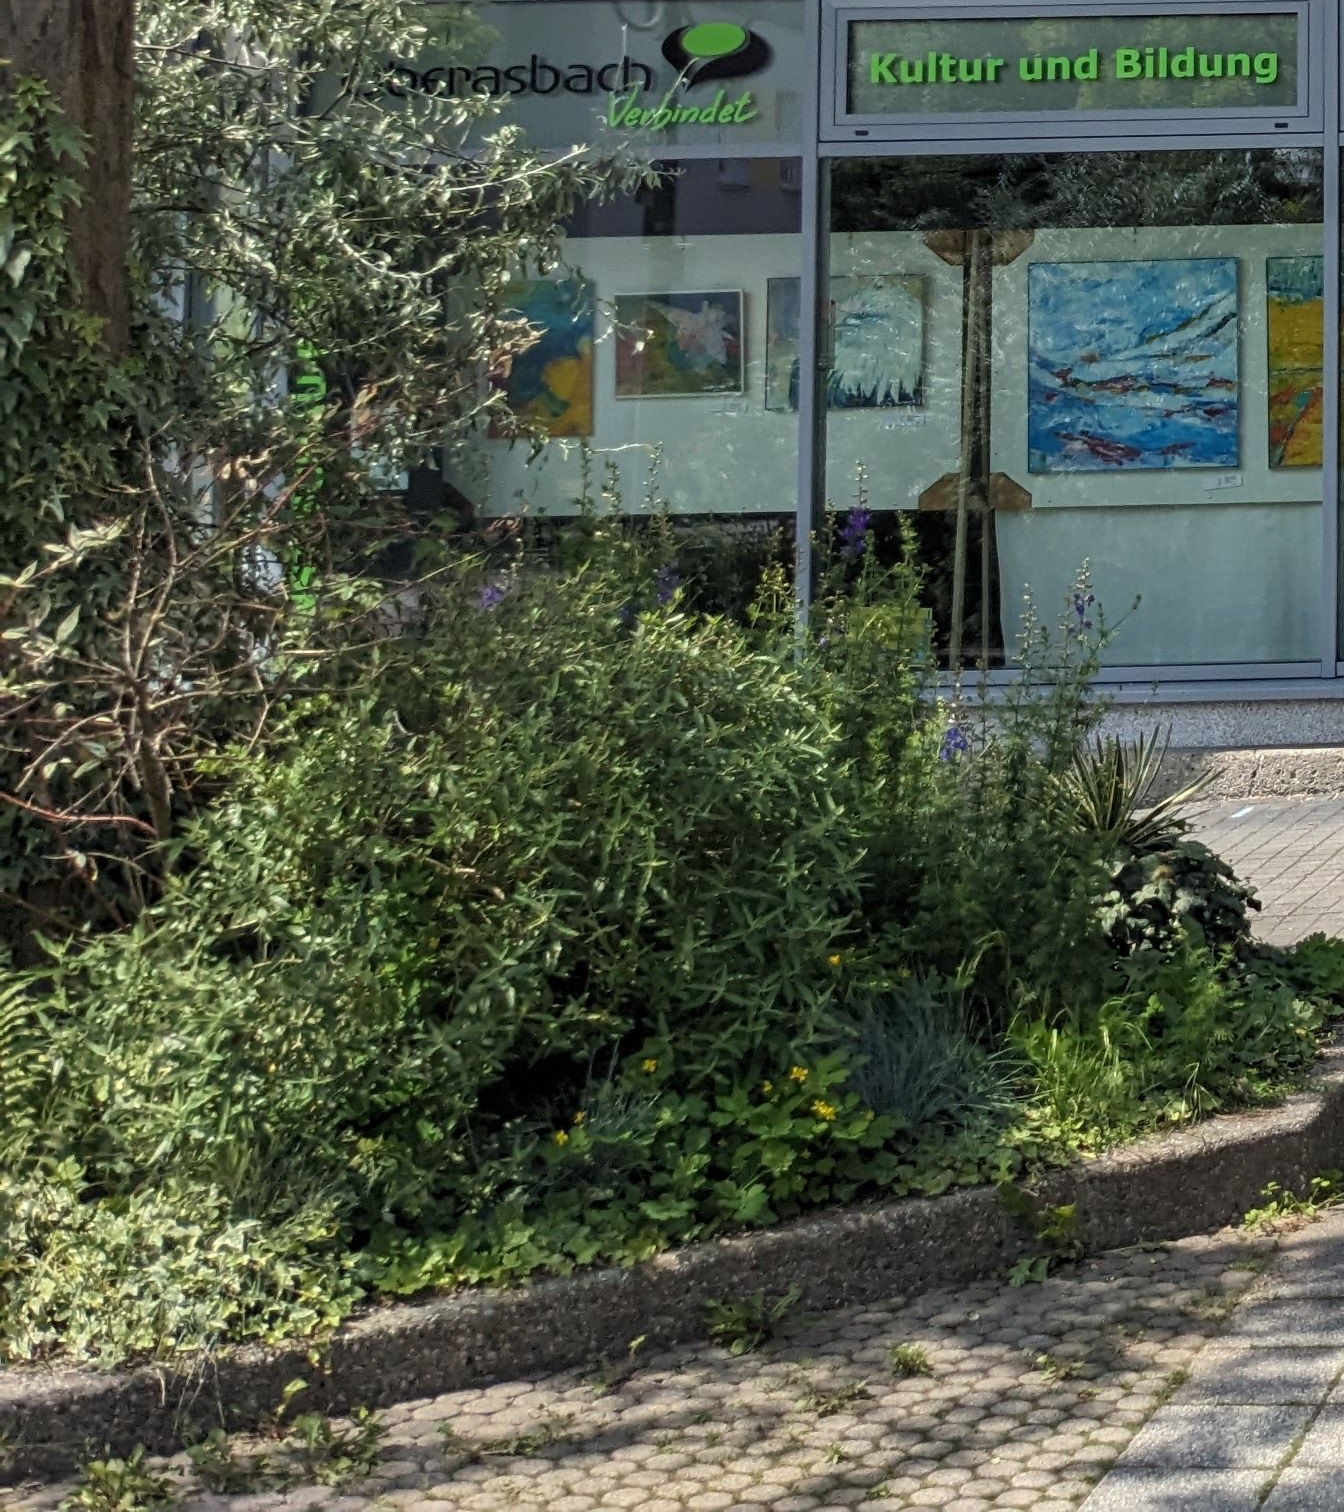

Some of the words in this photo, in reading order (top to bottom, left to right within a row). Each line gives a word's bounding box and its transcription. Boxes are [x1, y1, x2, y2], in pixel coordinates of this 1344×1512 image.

[868, 51, 1004, 85] Kultur
[1017, 47, 1100, 83] und
[1113, 45, 1279, 85] Bildung
